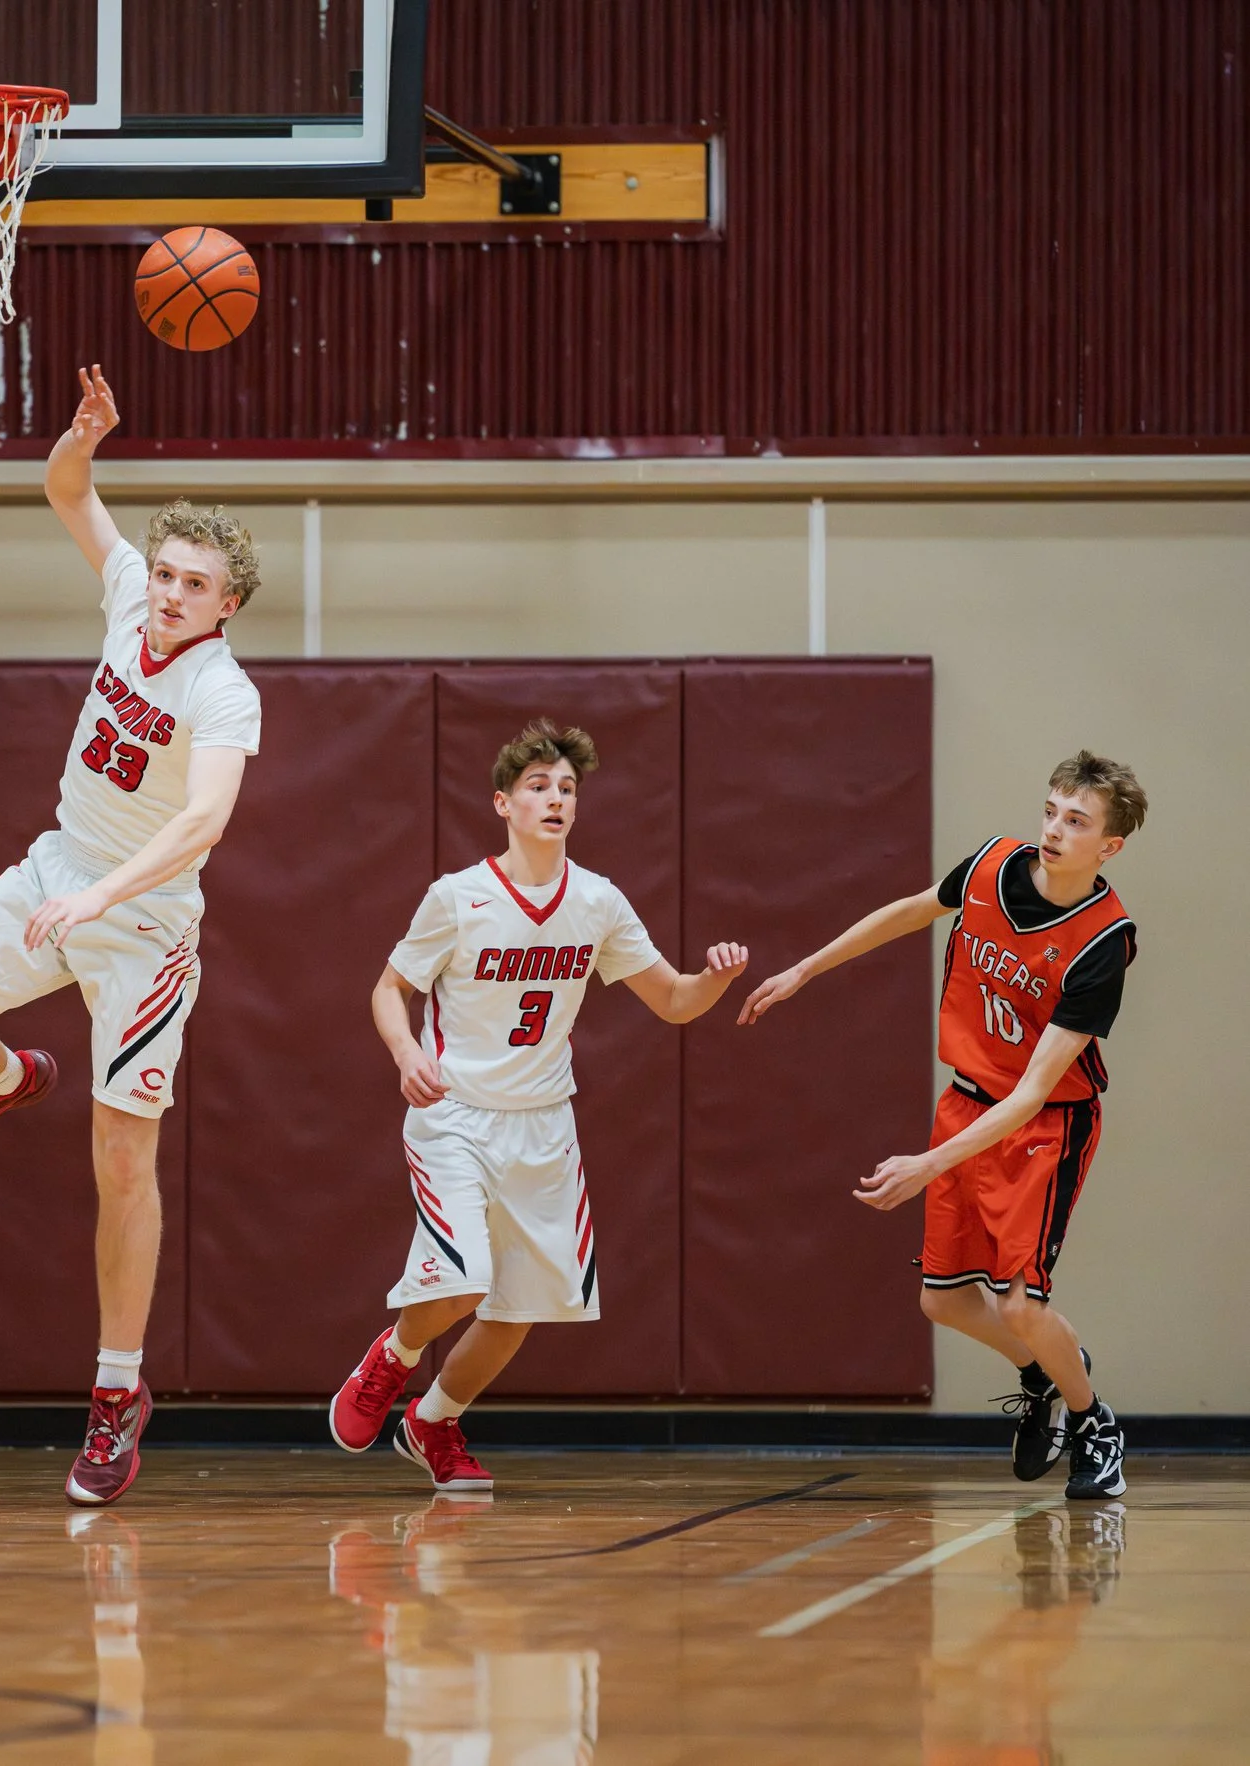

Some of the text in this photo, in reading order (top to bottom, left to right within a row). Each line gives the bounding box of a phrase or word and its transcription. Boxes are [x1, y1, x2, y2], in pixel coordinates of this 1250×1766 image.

[95, 662, 176, 746] CAMAS
[81, 717, 149, 792] 33
[474, 944, 594, 981] CAMAS
[962, 931, 1048, 1000] TIGERS
[508, 990, 553, 1047] 3
[978, 983, 1025, 1046] 10
[140, 1068, 166, 1090] C
